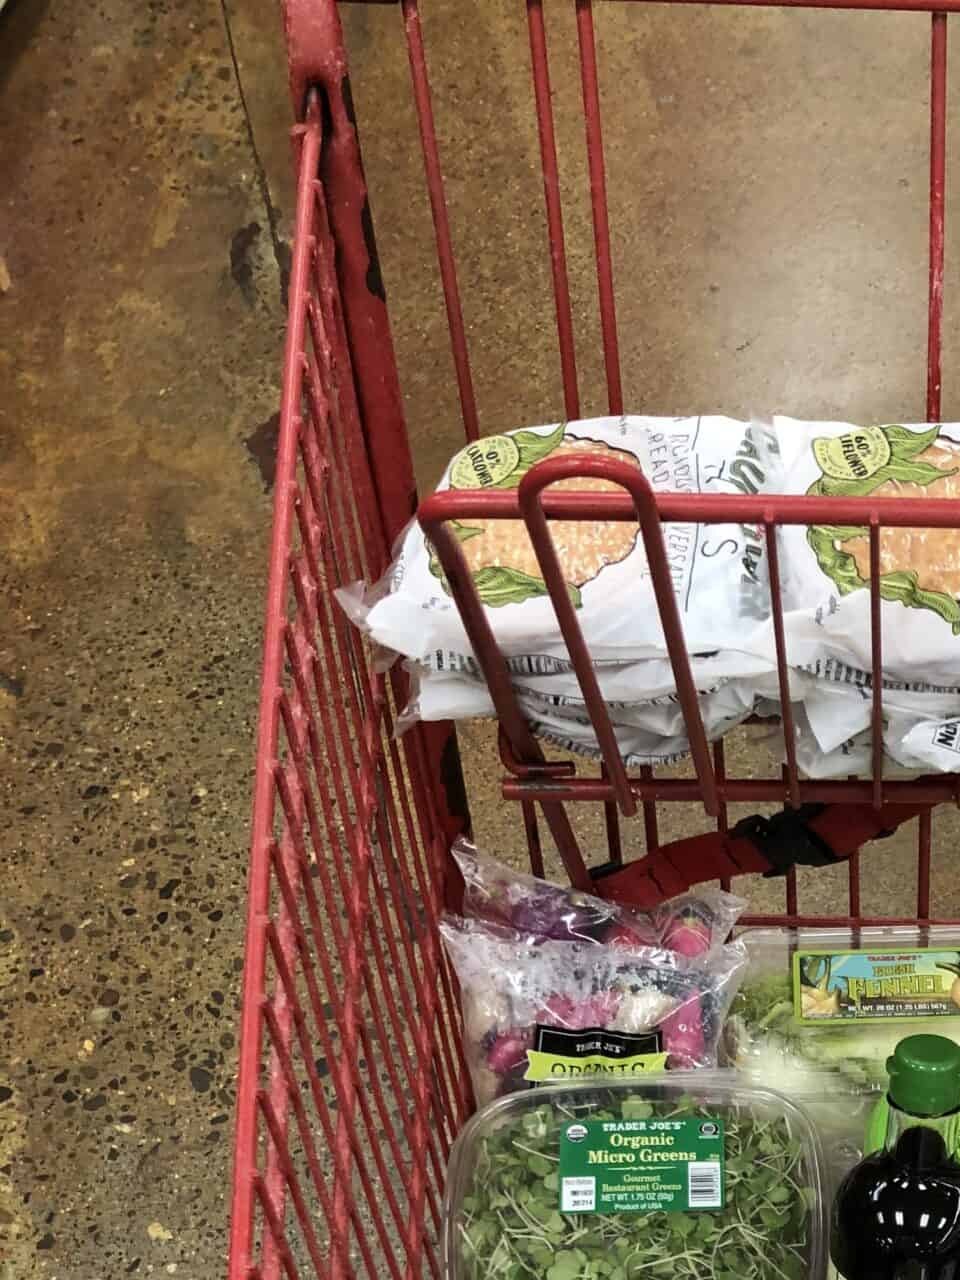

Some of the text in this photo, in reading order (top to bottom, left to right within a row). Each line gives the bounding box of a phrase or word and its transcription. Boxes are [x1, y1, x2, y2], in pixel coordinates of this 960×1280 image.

[602, 1122, 682, 1131] TRADER JOE'S
[610, 1133, 674, 1148] Organic
[588, 1150, 635, 1164] Micro
[640, 1148, 697, 1162] Greens
[602, 1183, 682, 1192] Restaurant Greens
[601, 1193, 615, 1201] NET
